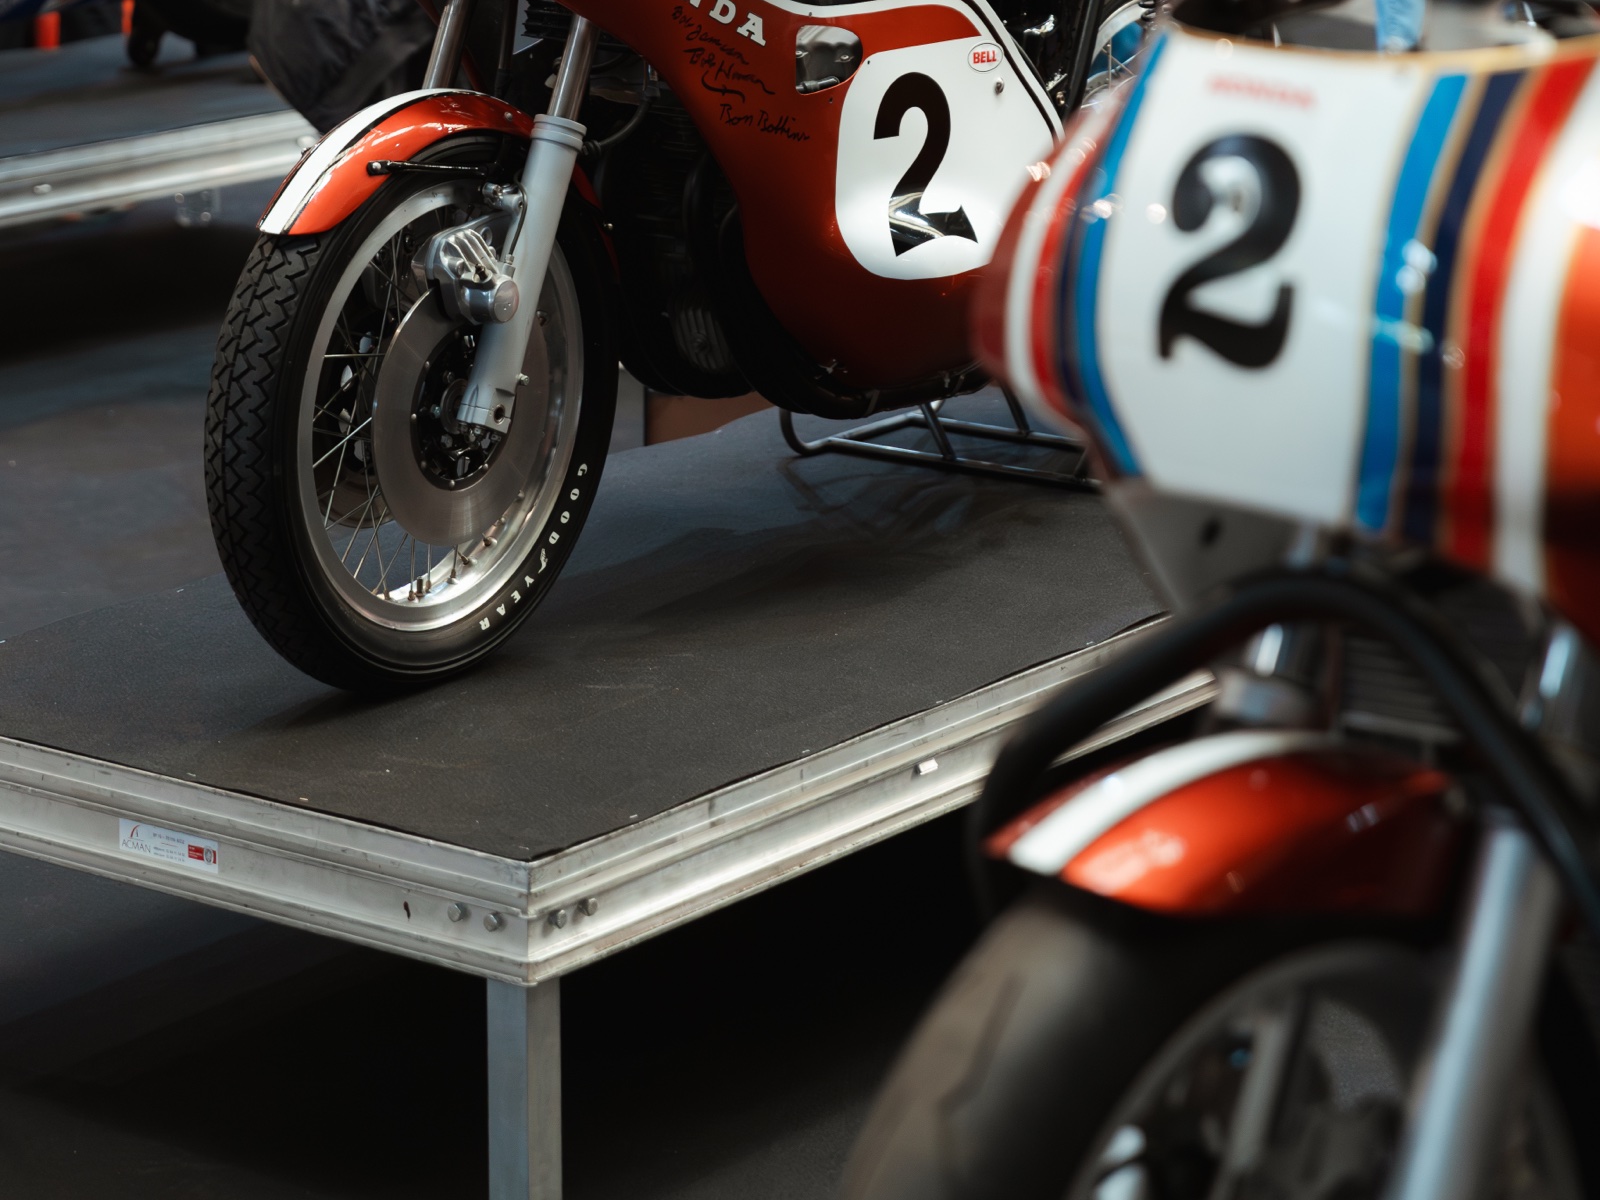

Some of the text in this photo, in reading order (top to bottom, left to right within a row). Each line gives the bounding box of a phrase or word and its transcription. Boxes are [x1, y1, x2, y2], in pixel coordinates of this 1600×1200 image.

[973, 50, 997, 64] BELL
[874, 71, 978, 257] 2
[1159, 132, 1303, 371] 2
[121, 838, 151, 854] ACMAN
